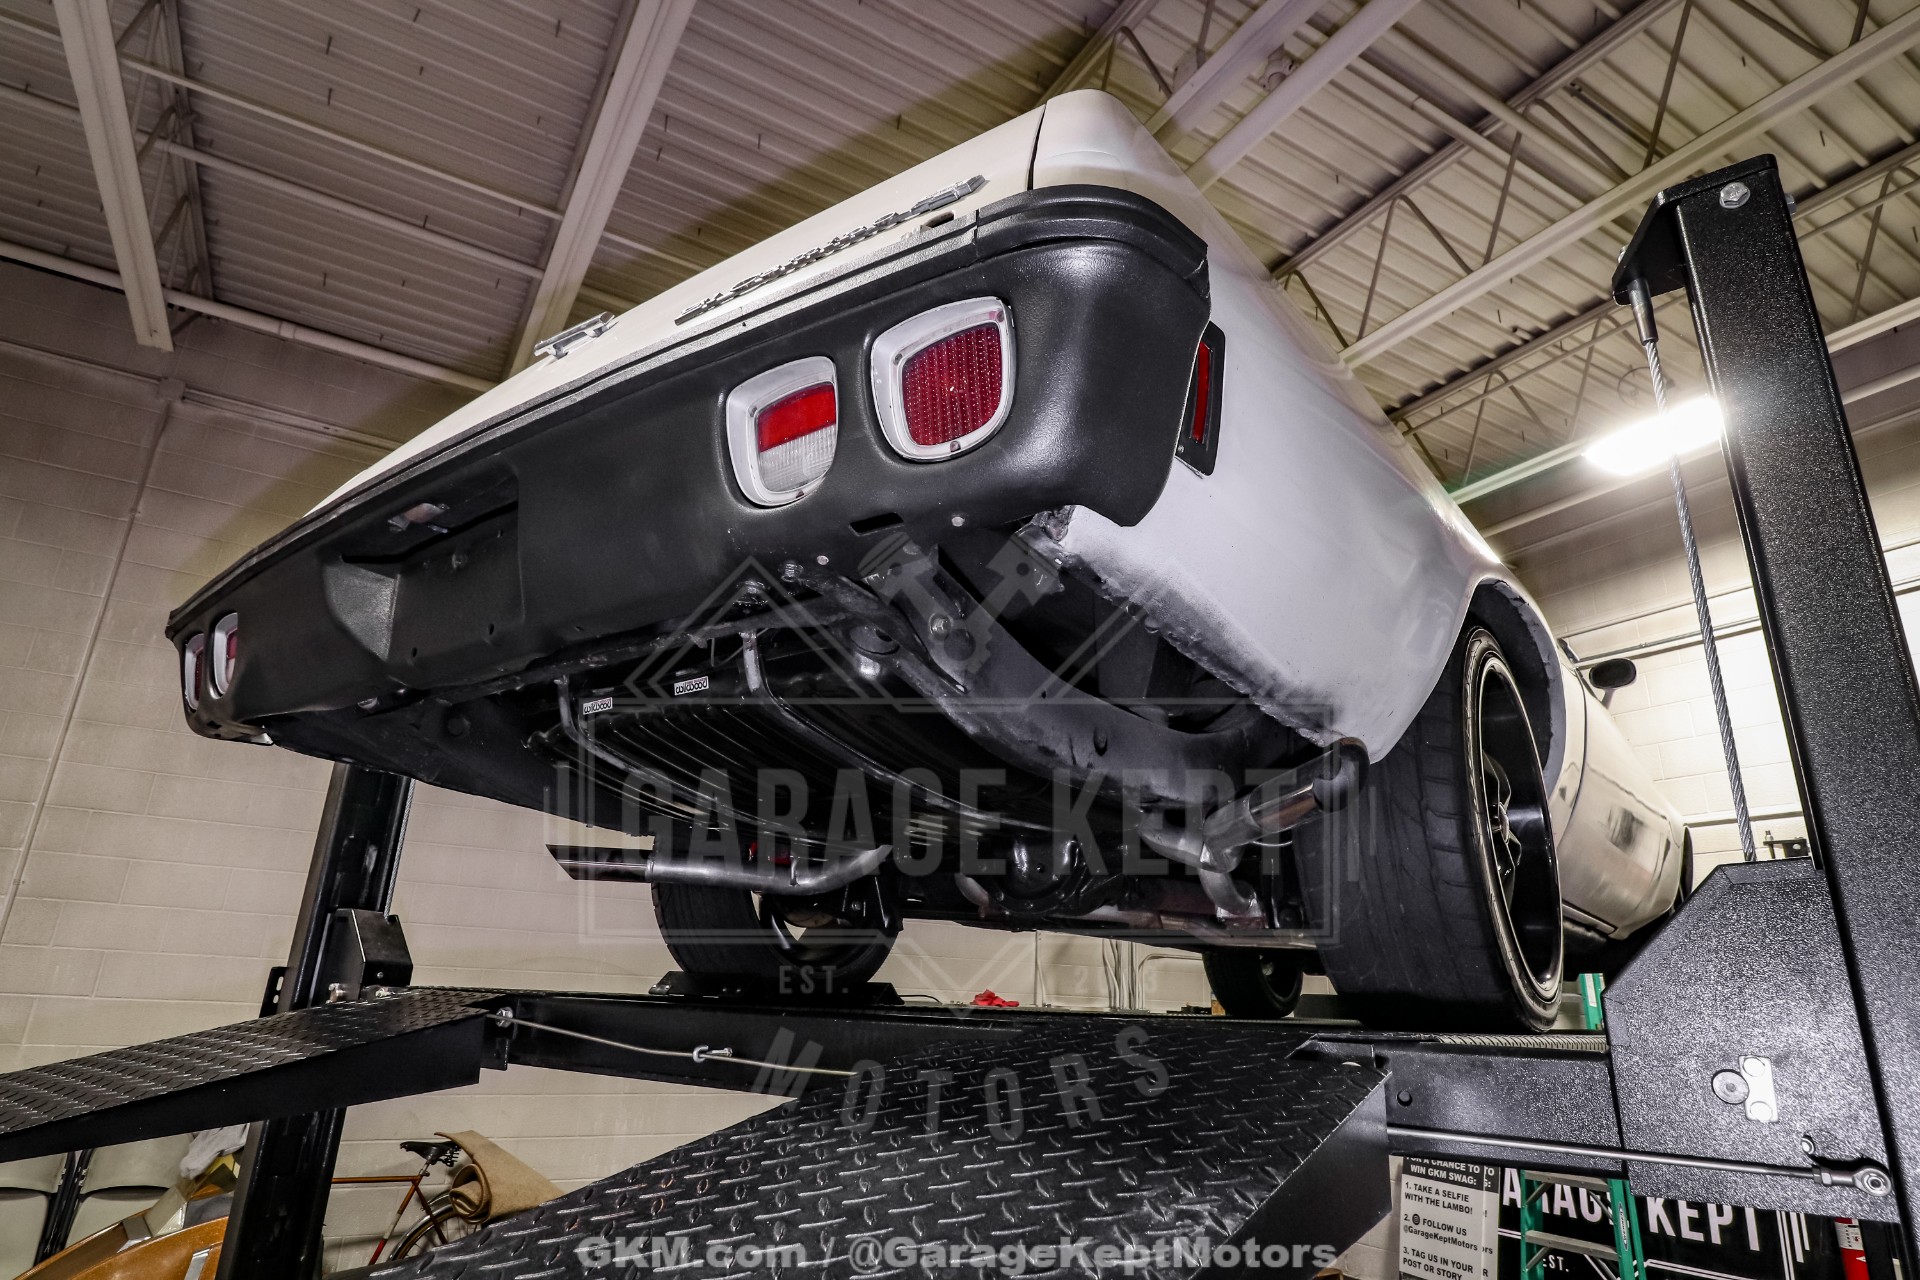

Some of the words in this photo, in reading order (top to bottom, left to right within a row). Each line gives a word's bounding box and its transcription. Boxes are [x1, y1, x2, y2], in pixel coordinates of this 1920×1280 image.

[1410, 1164, 1426, 1175] WIN
[1427, 1168, 1447, 1179] GKM
[1448, 1172, 1477, 1185] SWAG:
[1468, 1163, 1480, 1174] TO
[1405, 1192, 1423, 1204] WITH
[1425, 1196, 1440, 1207] THE
[1442, 1201, 1473, 1215] LAMBO!
[1413, 1183, 1432, 1195] TAKE
[1434, 1188, 1440, 1196] A
[1442, 1190, 1469, 1203] SELFIE
[1404, 1213, 1411, 1222] 2.
[1422, 1218, 1454, 1233] FOLLOW
[1456, 1226, 1467, 1237] US
[1404, 1225, 1478, 1251] @GarageKeptMotors
[1403, 1246, 1410, 1255] 3.
[1411, 1248, 1426, 1260] TAG
[1427, 1253, 1438, 1263] US
[1440, 1257, 1449, 1266] IN
[1451, 1259, 1474, 1274] YOUR
[1403, 1258, 1422, 1268] POST
[1423, 1263, 1435, 1274] OR
[1436, 1268, 1463, 1280] STORY
